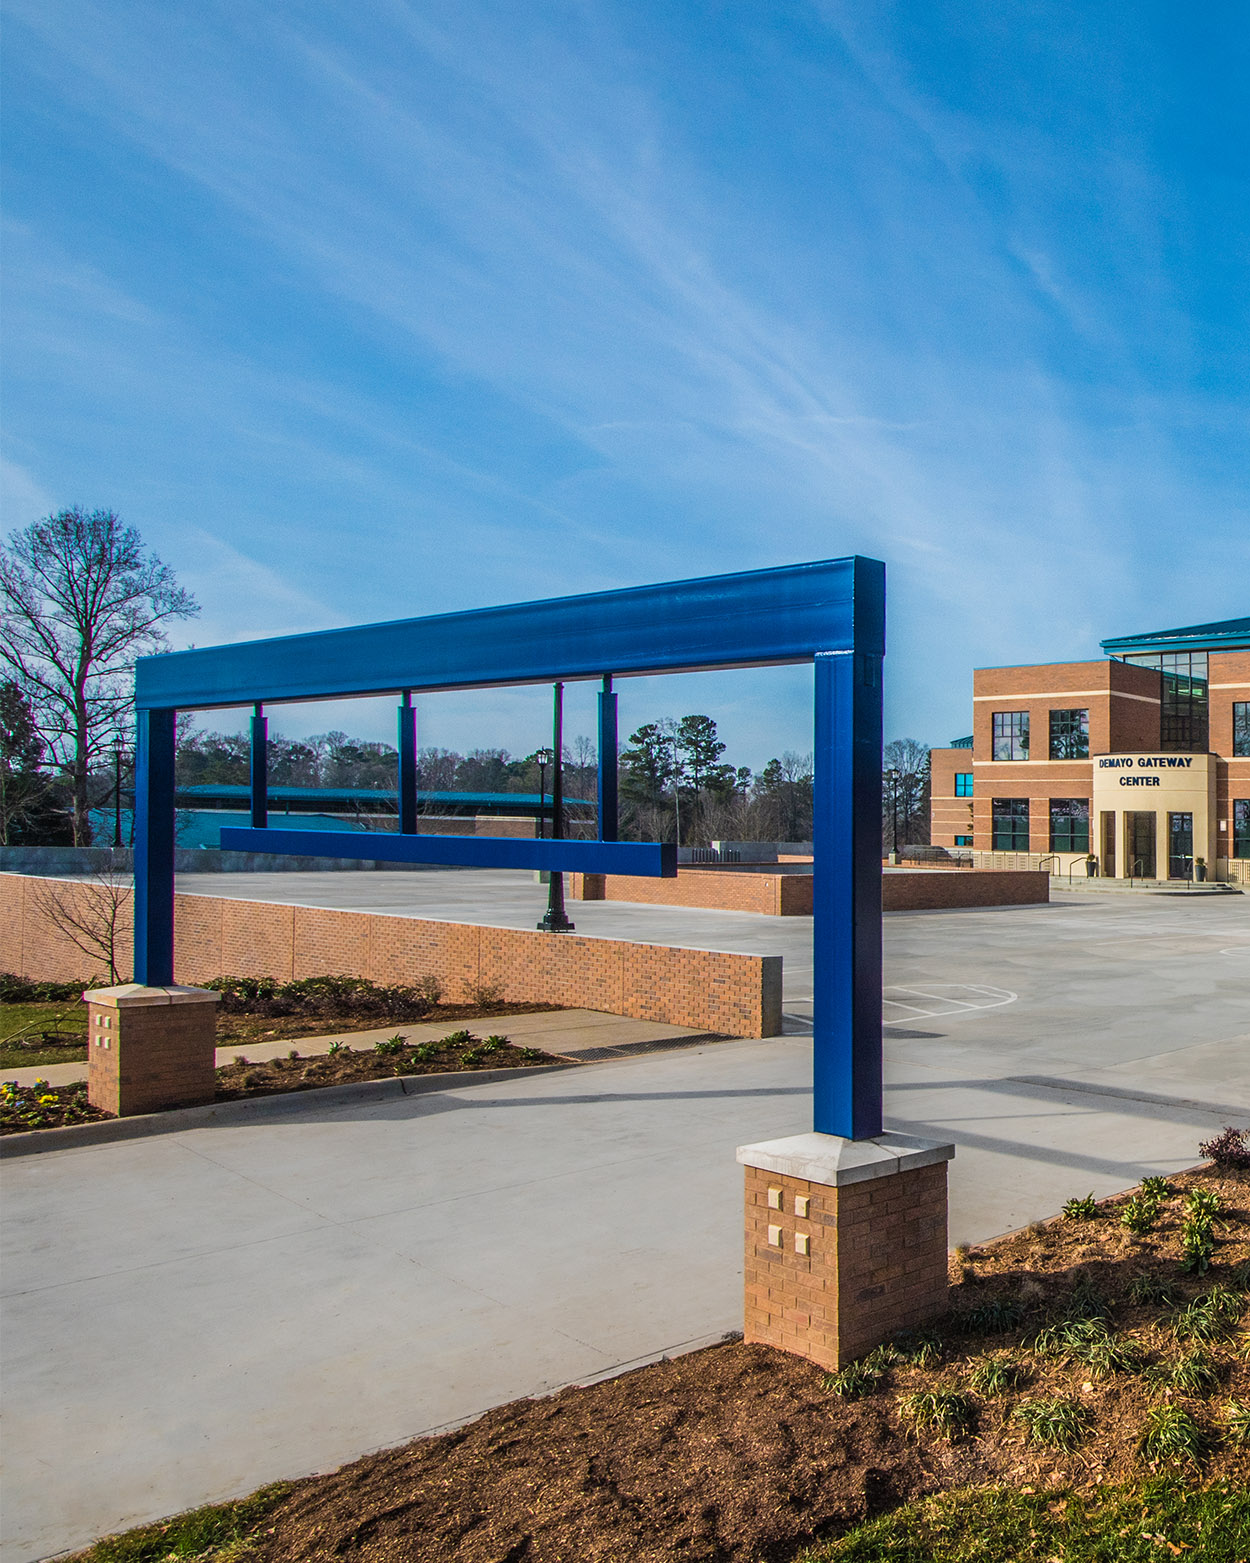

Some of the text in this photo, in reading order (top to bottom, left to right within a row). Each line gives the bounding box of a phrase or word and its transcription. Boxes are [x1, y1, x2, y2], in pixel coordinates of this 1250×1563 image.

[1099, 757, 1193, 769] DEMAYO GATEWAY
[1119, 776, 1160, 787] CENTER
